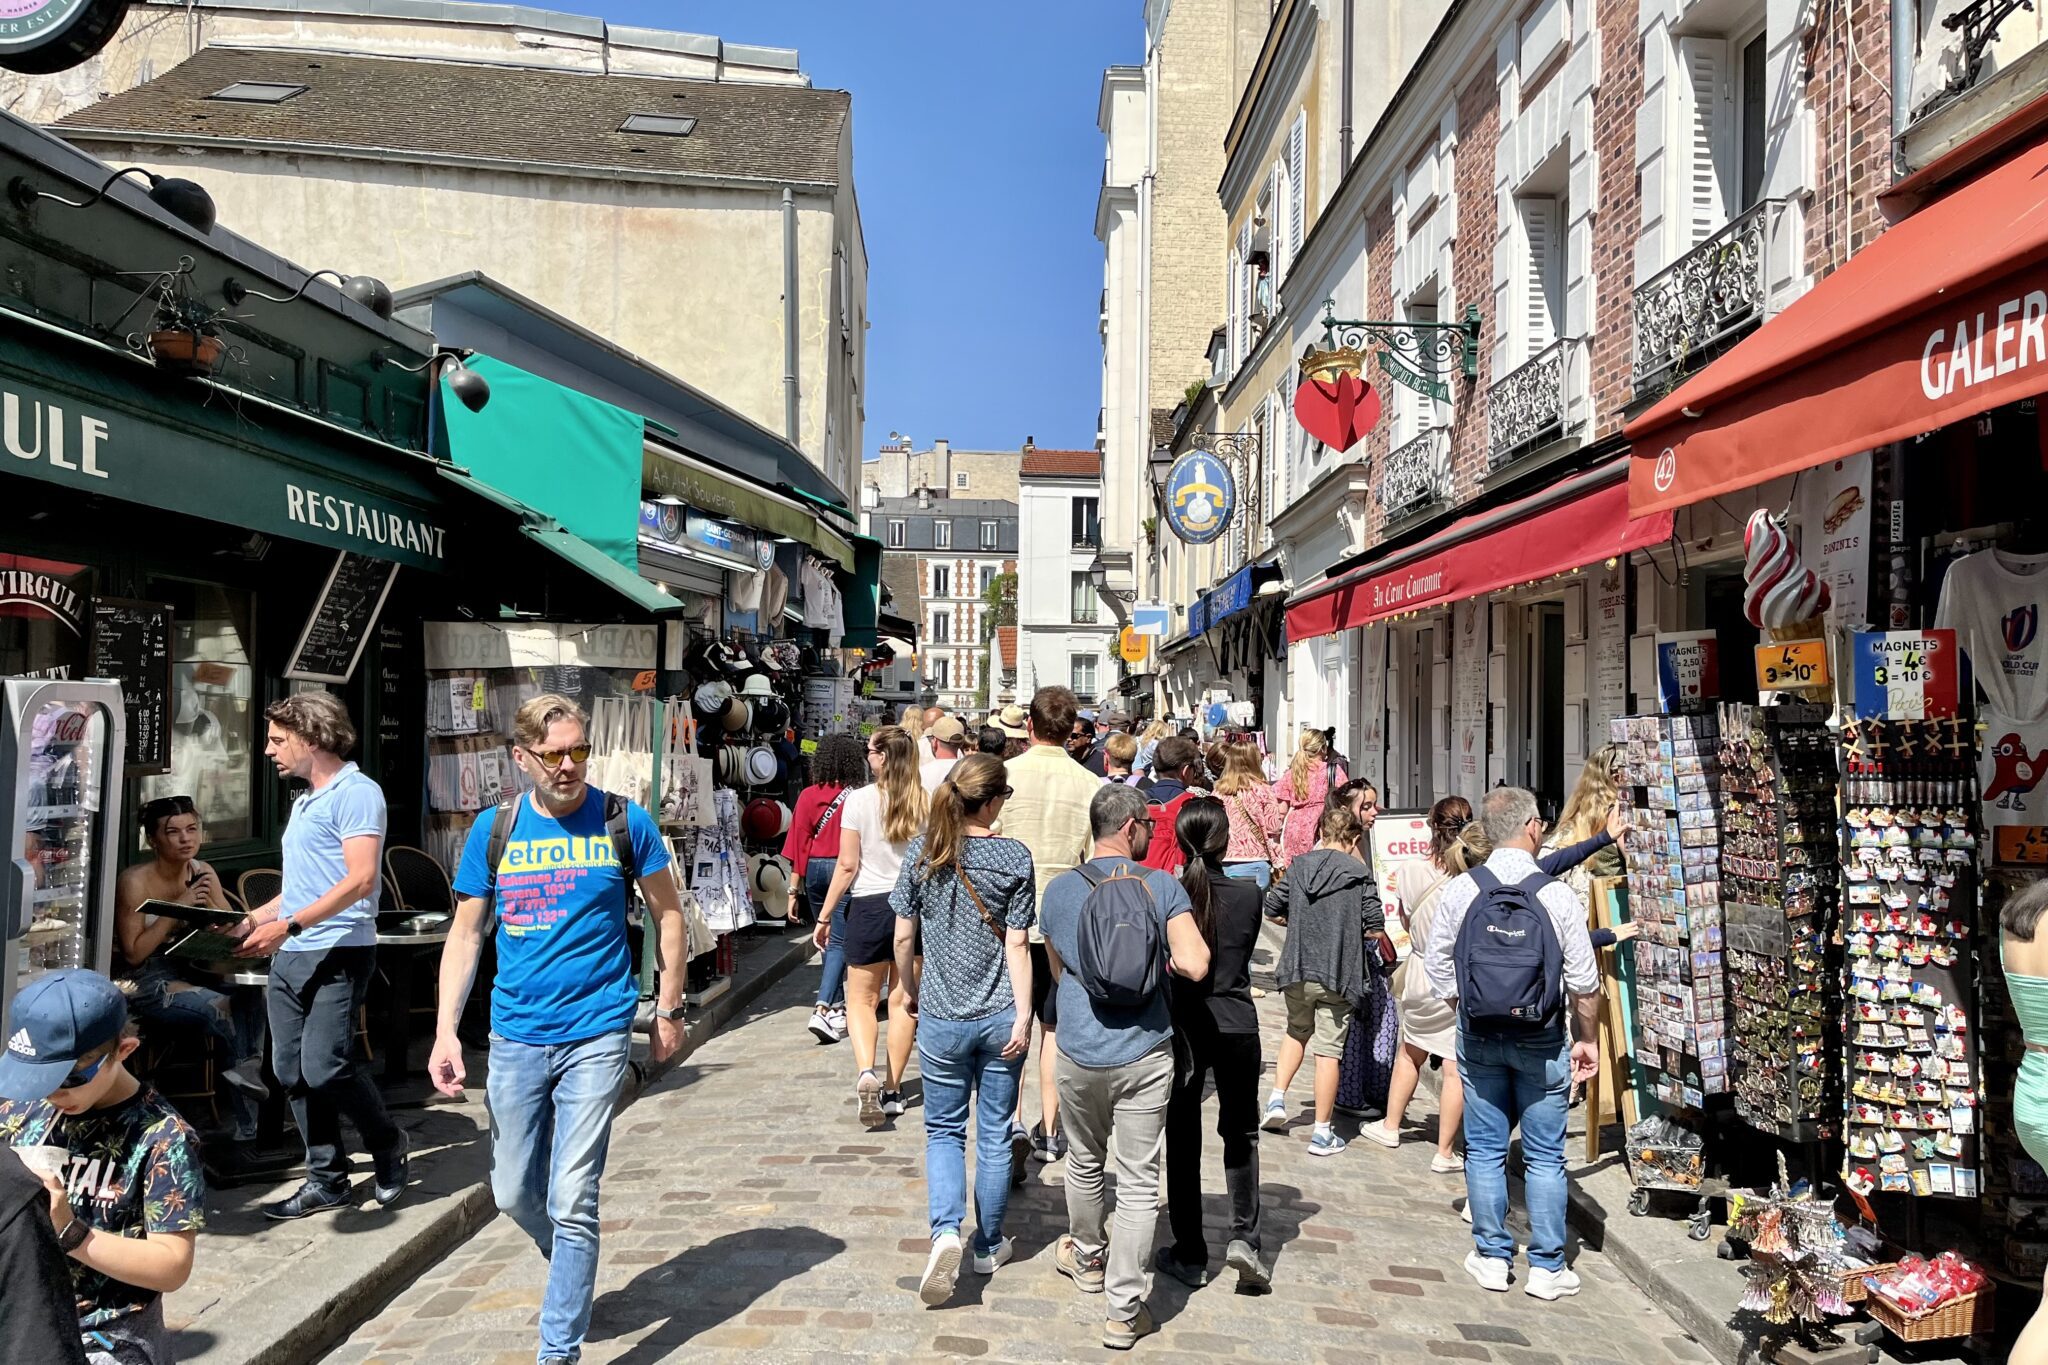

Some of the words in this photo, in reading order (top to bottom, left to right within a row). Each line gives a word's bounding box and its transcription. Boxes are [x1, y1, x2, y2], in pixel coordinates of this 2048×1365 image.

[1921, 289, 2048, 400] GALER
[3, 391, 109, 479] ULE
[1658, 455, 1674, 481] 42
[286, 483, 446, 559] RESTAURANT
[1823, 536, 1859, 555] PANINIS
[1668, 646, 1707, 656] MAGNETS
[1872, 640, 1938, 652] MAGNETS
[1683, 658, 1699, 667] 2,50
[1884, 657, 1890, 667] 1
[1688, 670, 1697, 678] 10
[1766, 668, 1777, 683] 3
[1875, 666, 1888, 684] 3
[1902, 671, 1918, 682] 10
[1922, 671, 1931, 680] €
[1487, 925, 1526, 937] Champion
[8, 1041, 36, 1057] adidas
